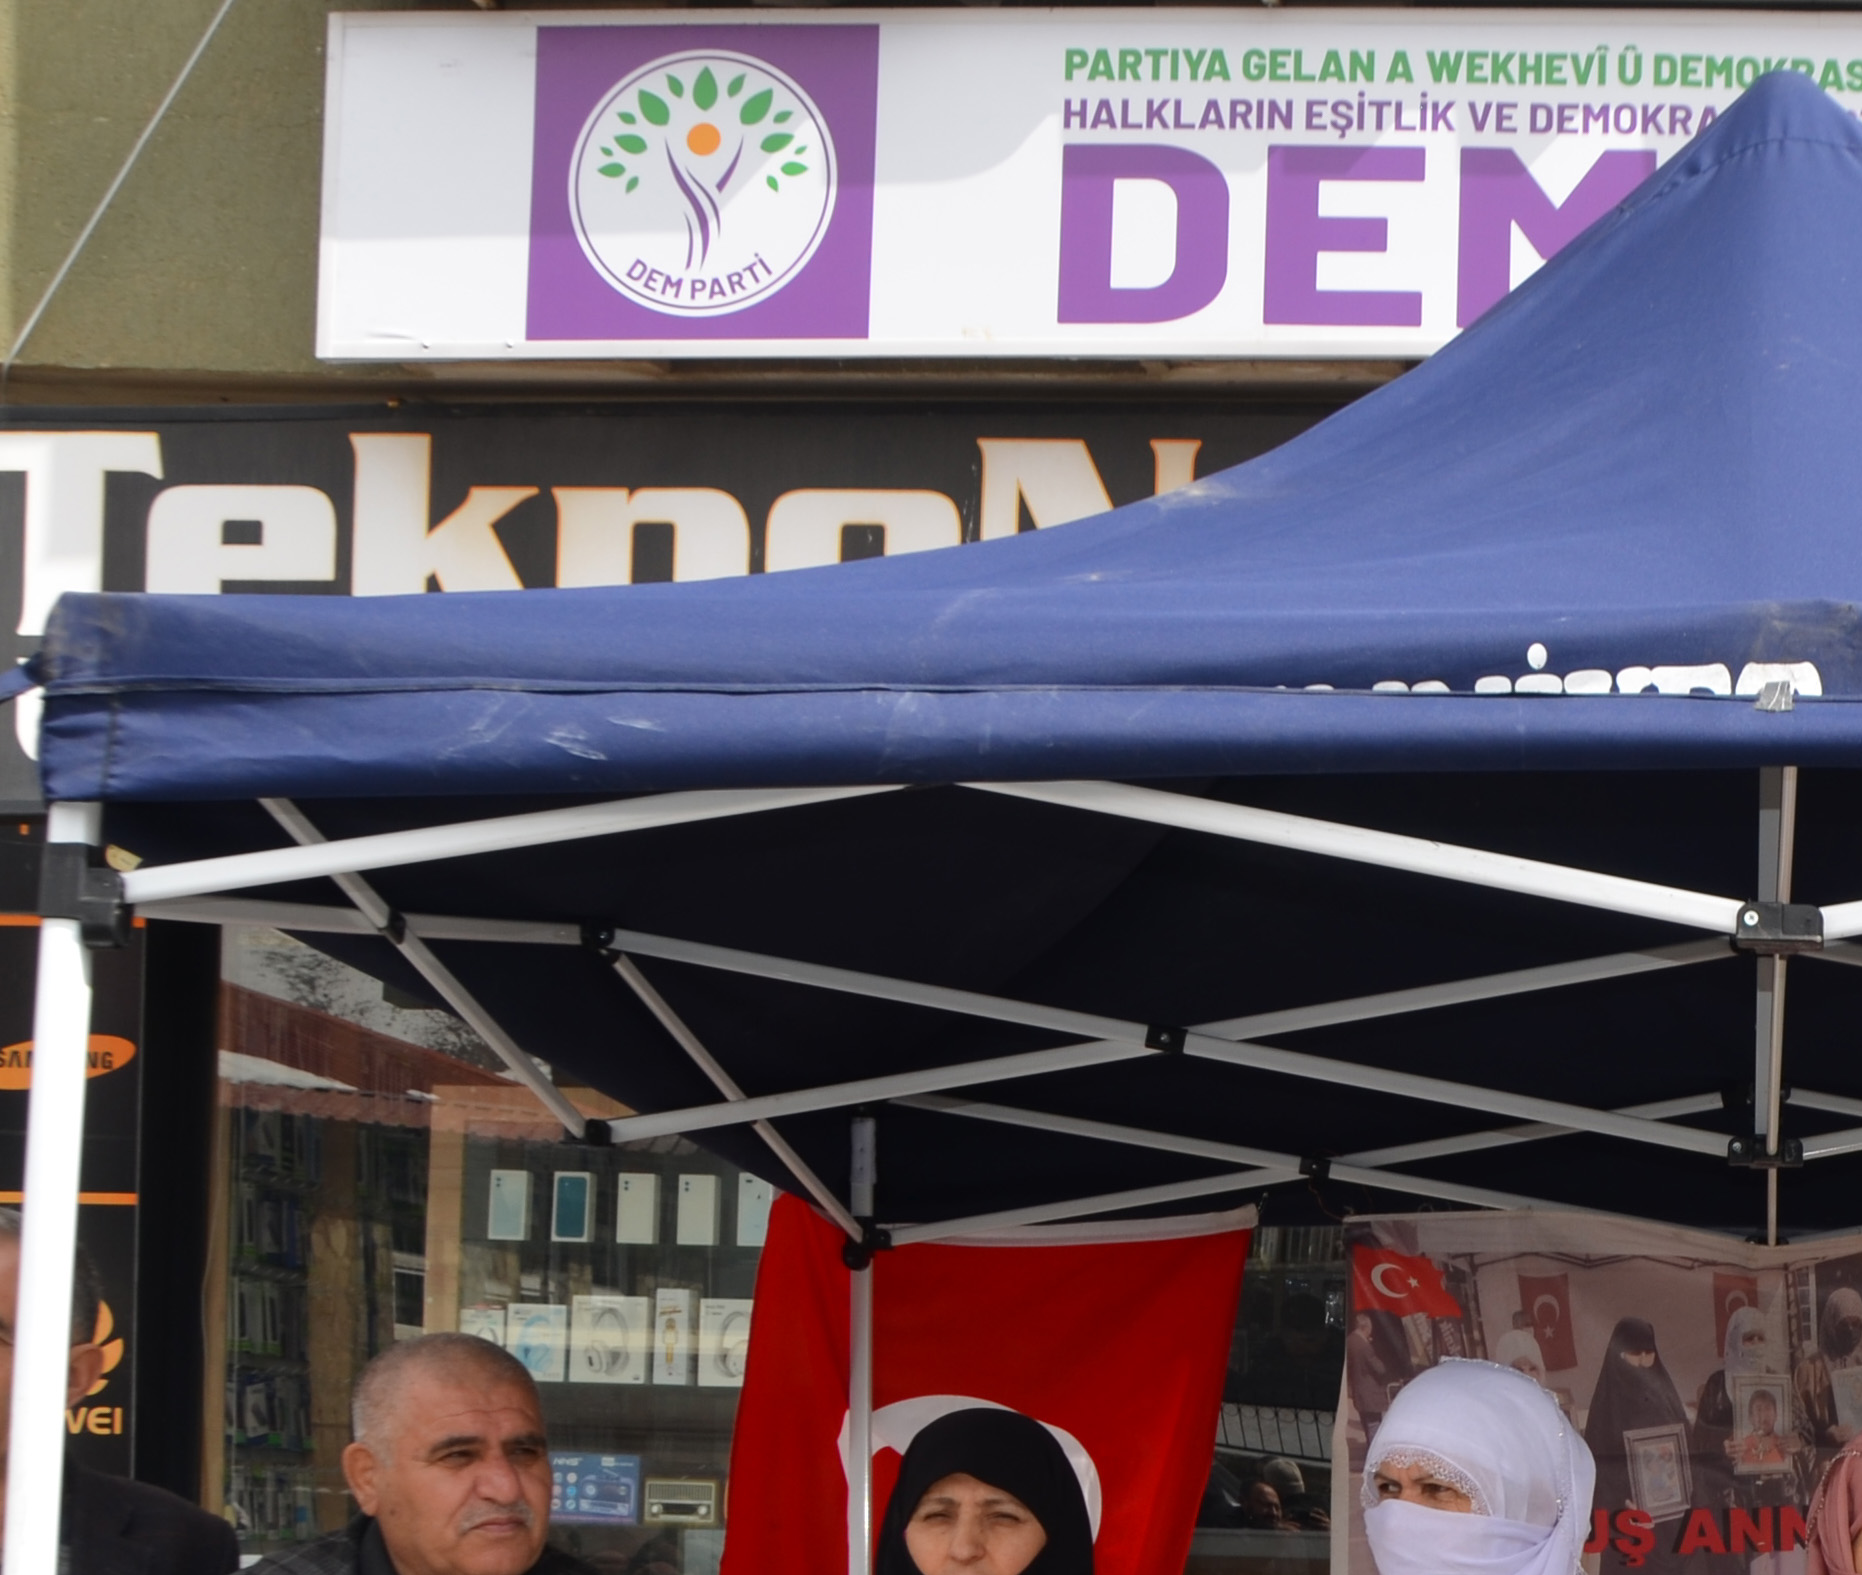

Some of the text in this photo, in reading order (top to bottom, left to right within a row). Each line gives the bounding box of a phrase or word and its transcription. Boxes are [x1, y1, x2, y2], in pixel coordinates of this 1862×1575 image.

[1063, 47, 1231, 82] PARTIYA
[1242, 48, 1375, 84] GELAN
[1385, 50, 1414, 84] A
[1426, 45, 1608, 87] WEKHEVÎ
[1617, 45, 1643, 87] Û
[1063, 97, 1293, 131] HALKLARIN
[1305, 90, 1456, 138] EŞİTLİK
[1468, 102, 1519, 134] VE
[626, 252, 774, 301] DEM PARTİ
